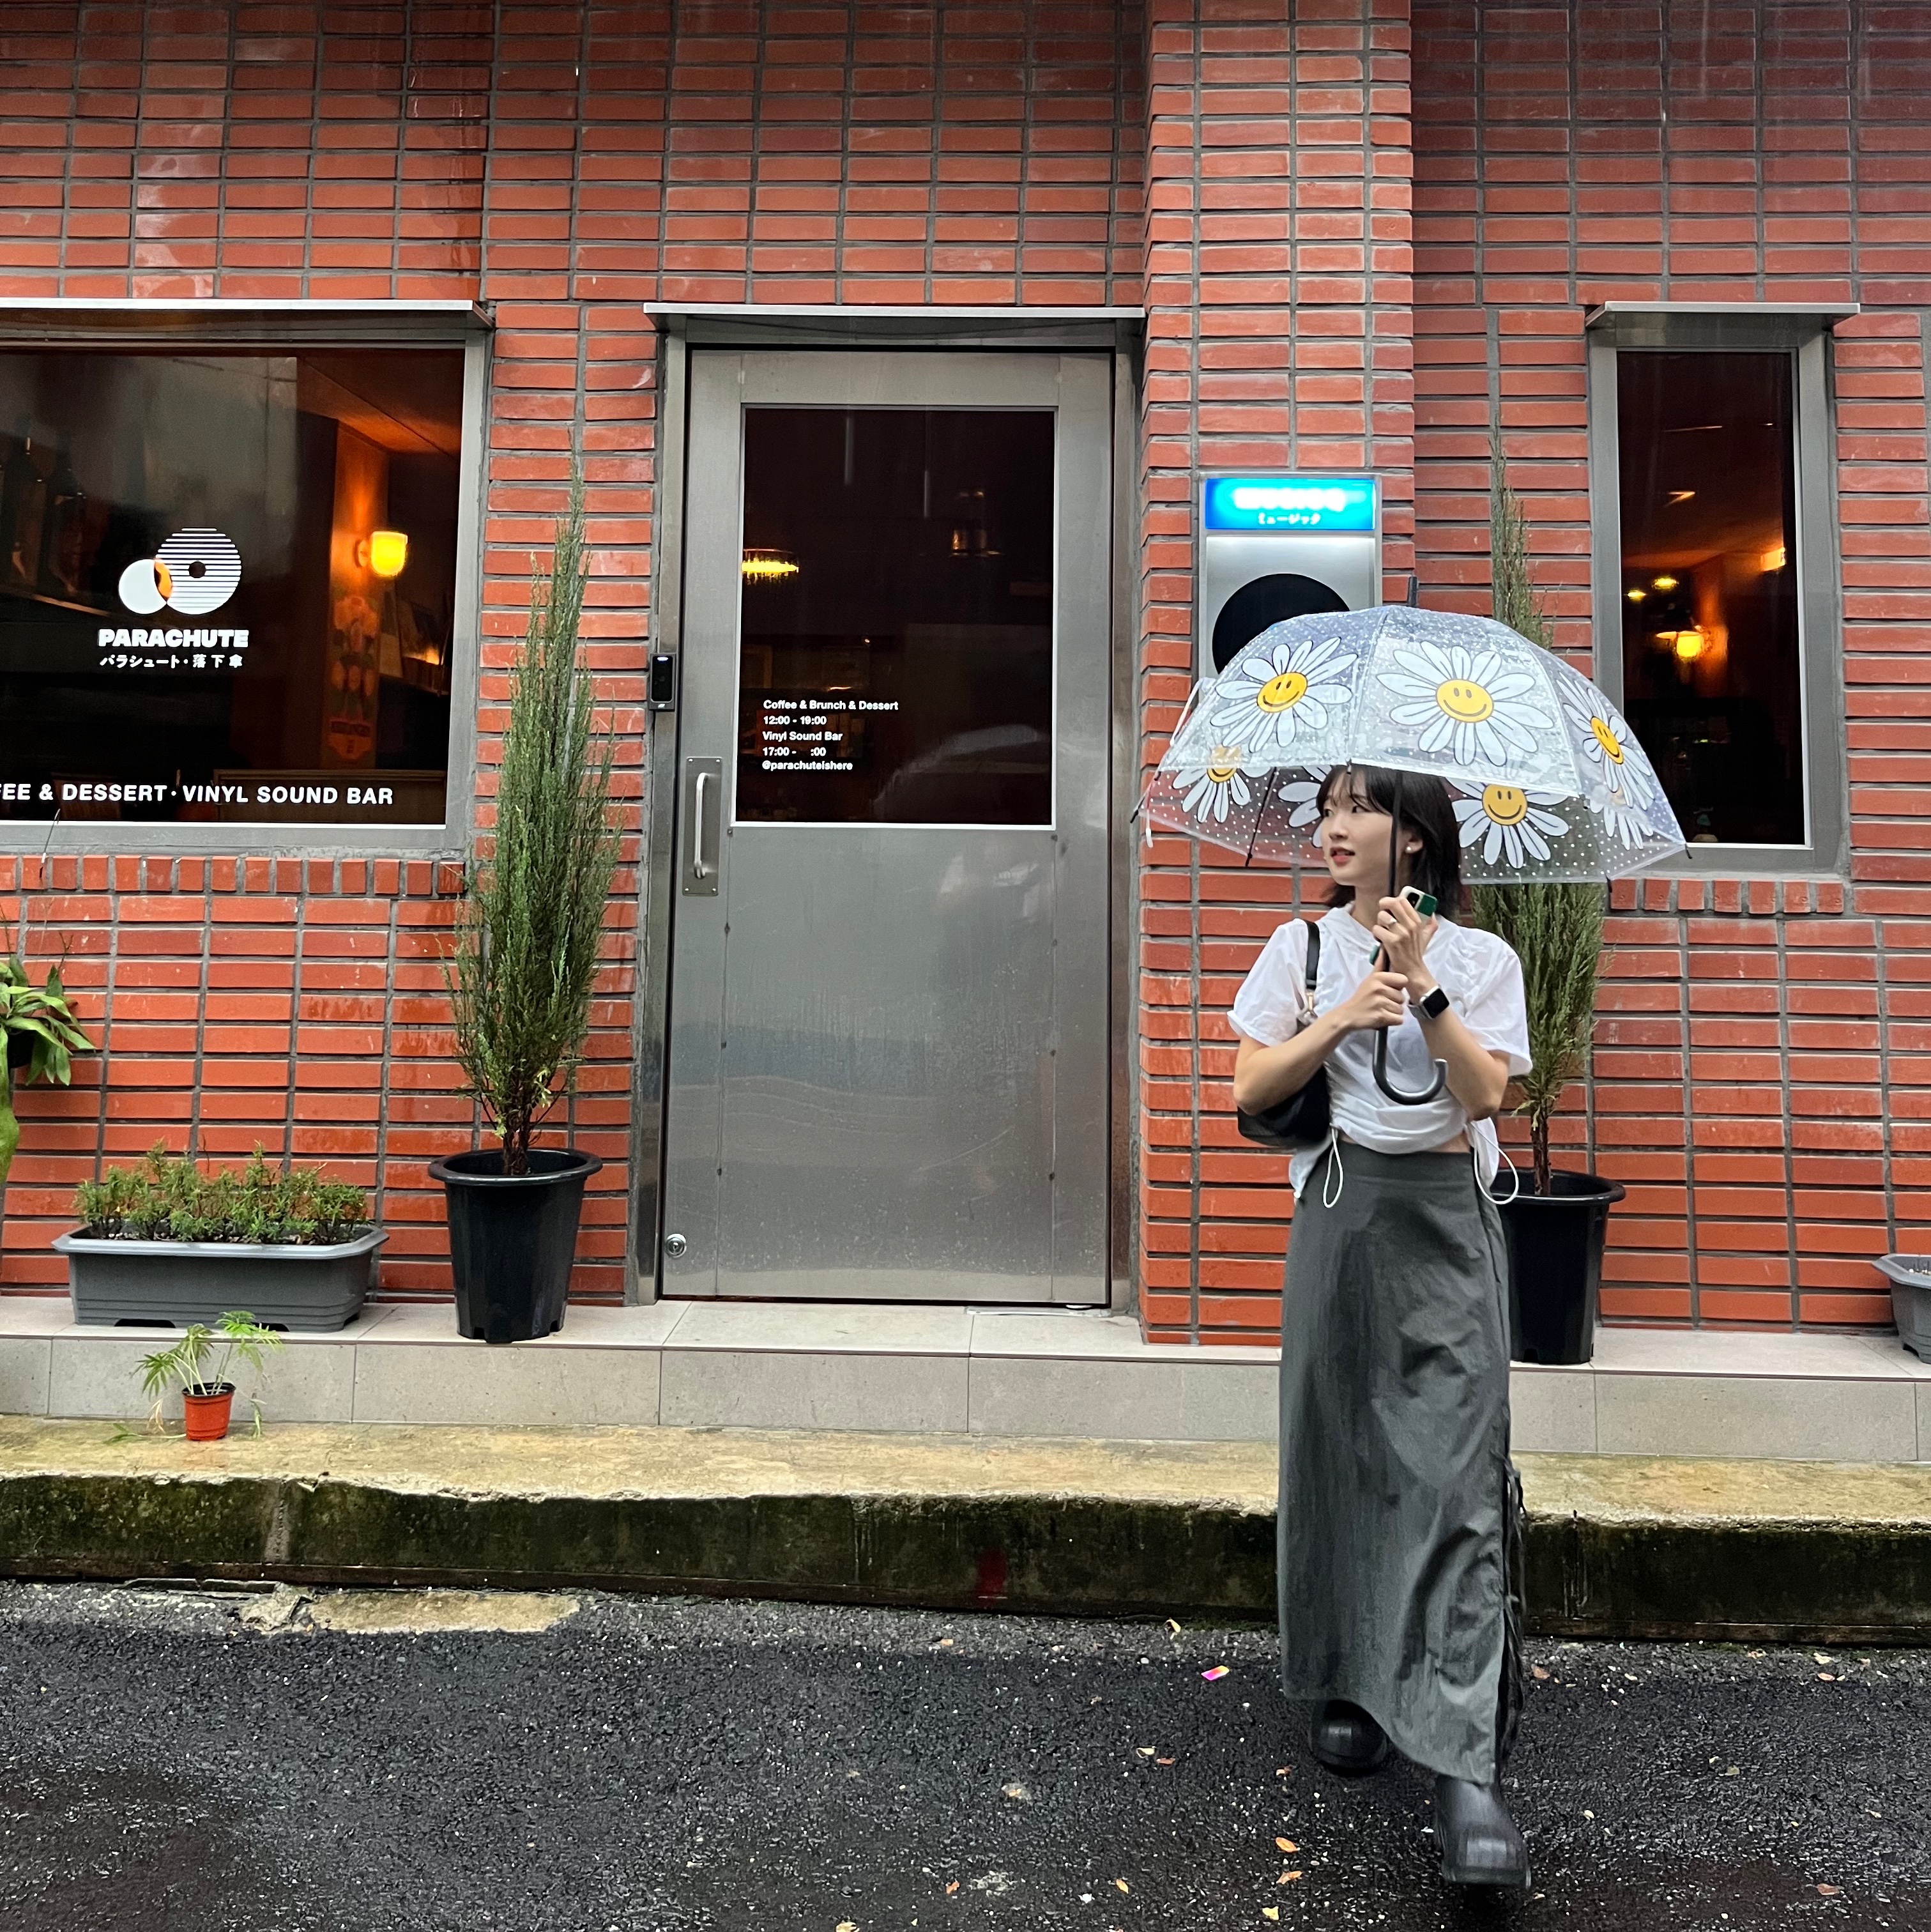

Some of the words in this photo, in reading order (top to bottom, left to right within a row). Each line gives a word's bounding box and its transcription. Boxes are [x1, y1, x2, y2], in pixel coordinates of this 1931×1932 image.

[98, 629, 249, 648] PARACHUTE
[763, 699, 798, 710] Coffee
[799, 700, 807, 710] &
[809, 700, 846, 710] Brunch
[848, 700, 857, 710] &
[859, 700, 899, 710] Dessert
[763, 715, 791, 725] 12:00
[800, 716, 827, 725] 19:00
[762, 731, 787, 742] Vinyl
[789, 731, 822, 741] Sound
[824, 732, 843, 741] Bar
[762, 746, 790, 756] 17:00
[761, 760, 853, 772] @parachuteishere
[0, 783, 31, 801] EE
[39, 783, 54, 801] &
[182, 785, 248, 803] VINYL
[256, 786, 338, 804] SOUND
[347, 787, 393, 805] BAR
